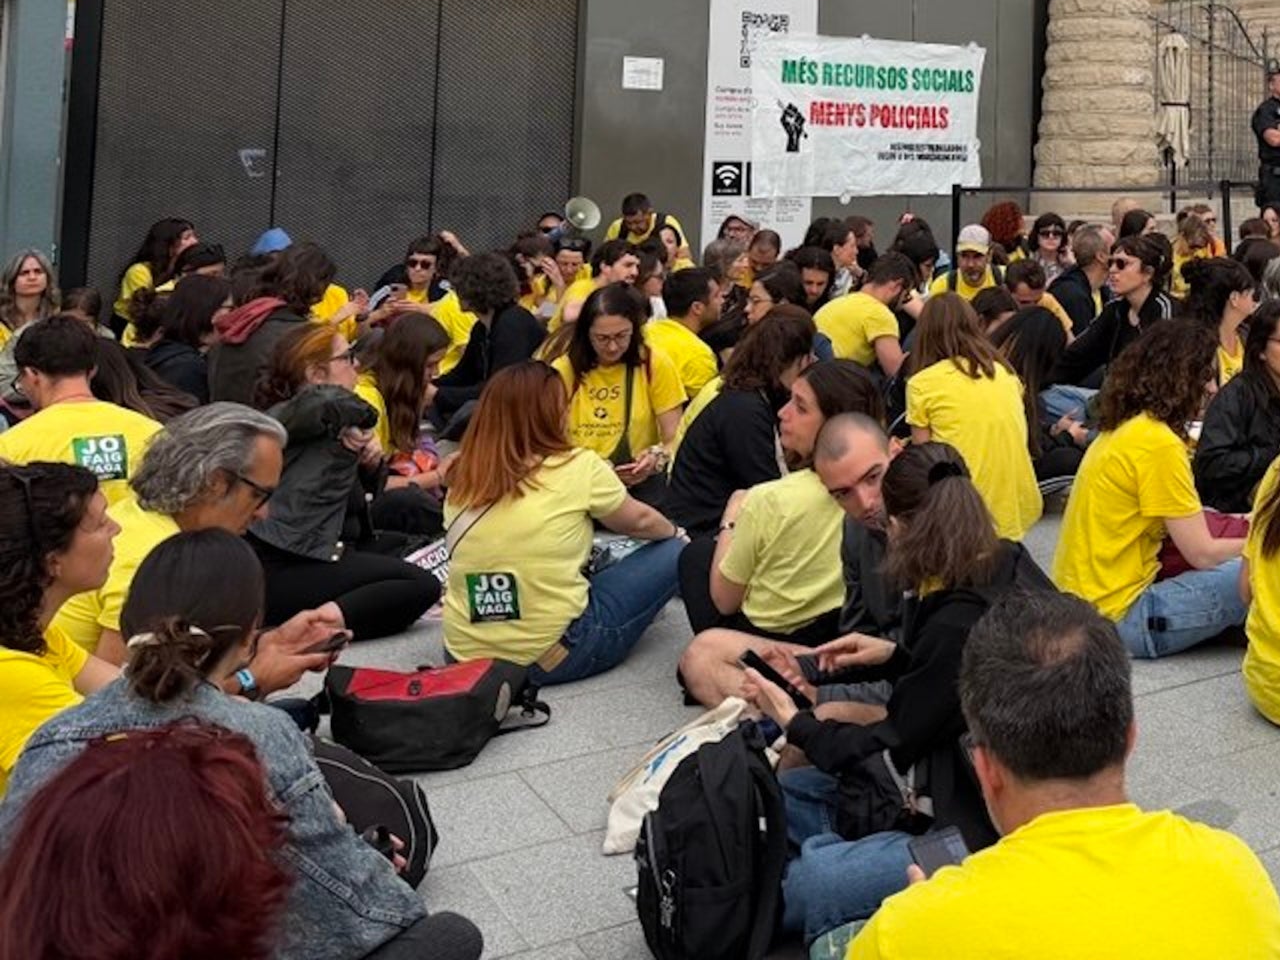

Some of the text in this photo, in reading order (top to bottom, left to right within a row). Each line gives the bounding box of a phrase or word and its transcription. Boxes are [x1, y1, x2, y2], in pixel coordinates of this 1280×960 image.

[782, 56, 974, 93] MÉS RECURSOS SOCIALS
[810, 102, 949, 130] MENYS POLICIALS
[81, 437, 119, 455] JO
[83, 451, 122, 467] FAIG
[475, 574, 510, 591] JO
[475, 591, 513, 604] FAIG
[476, 604, 514, 615] VAGA
